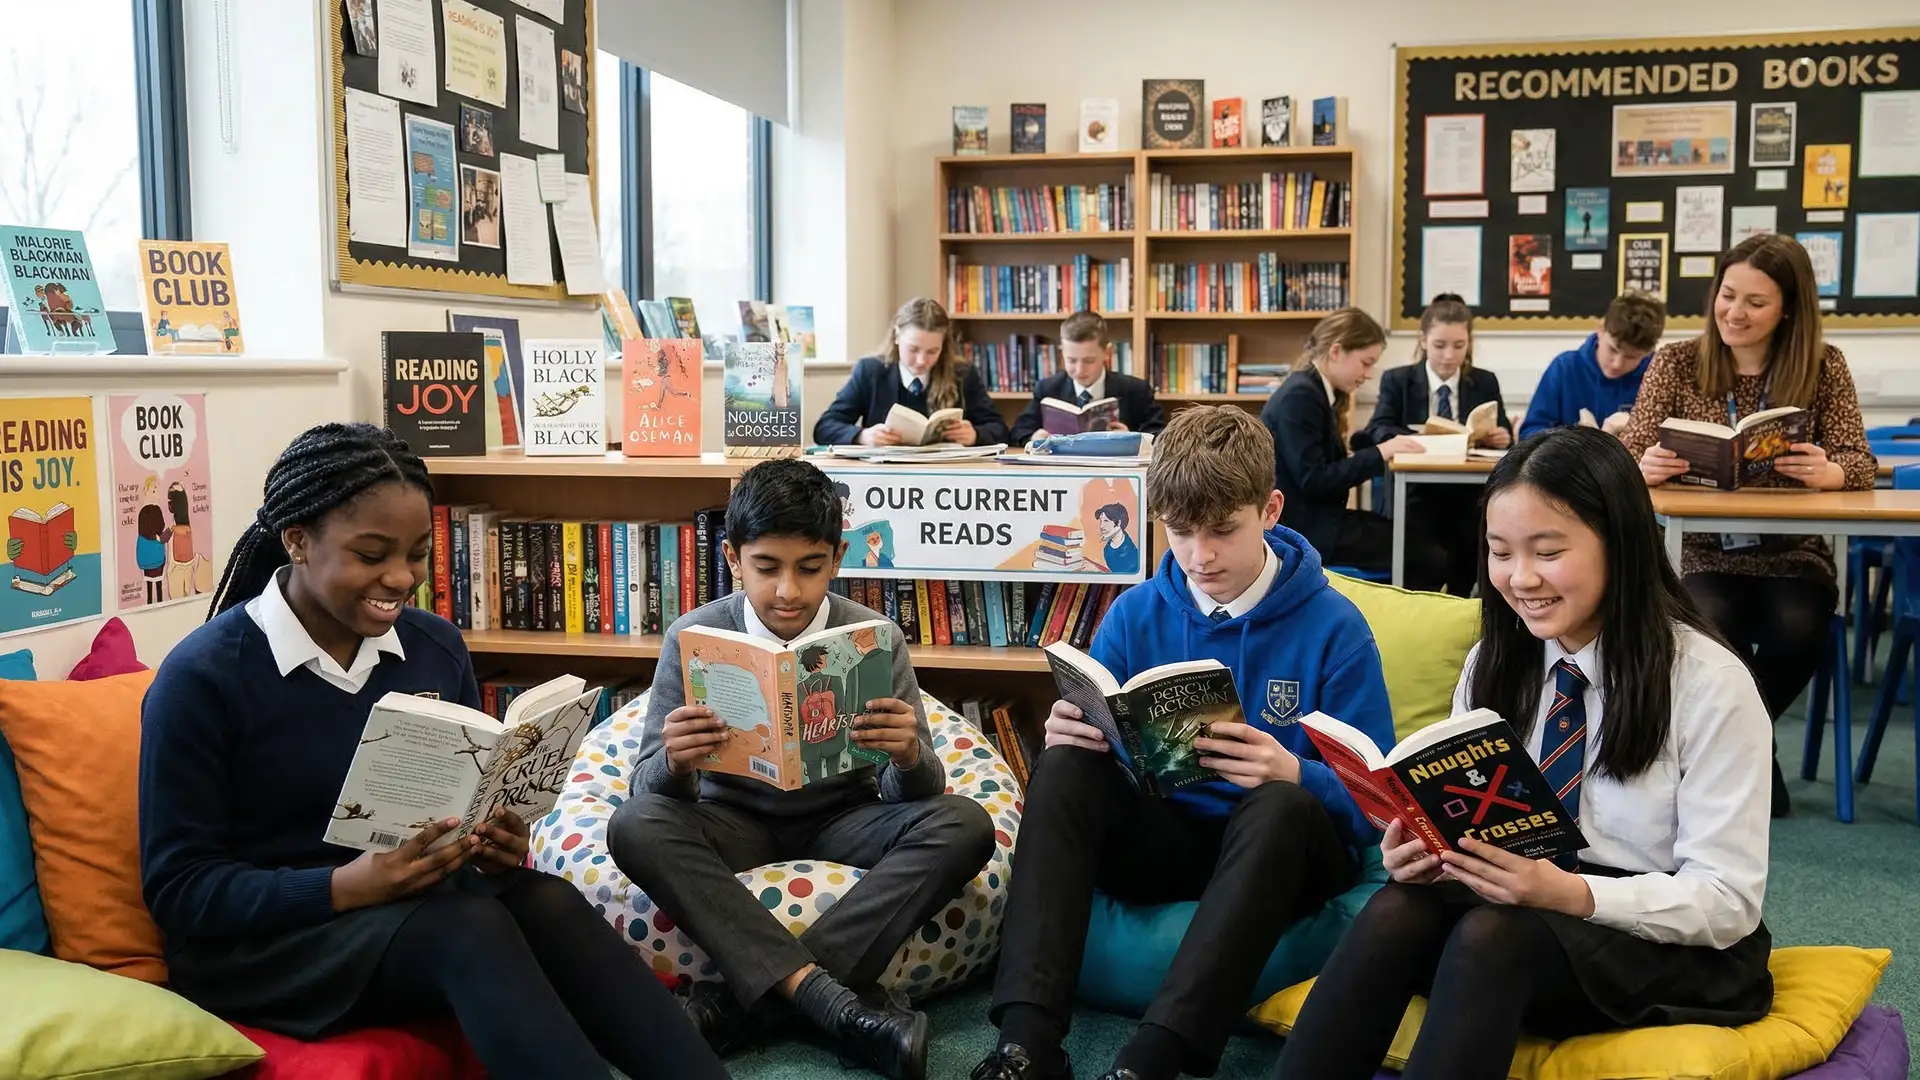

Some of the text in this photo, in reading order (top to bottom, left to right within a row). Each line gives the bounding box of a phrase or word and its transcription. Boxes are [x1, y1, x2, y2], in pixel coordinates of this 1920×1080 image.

[1454, 53, 1900, 101] RECOMMENDED BOOKS
[14, 235, 74, 250] MALORIE
[10, 248, 84, 264] BLACKMAN
[148, 249, 226, 276] BOOK
[13, 264, 91, 281] BLACKMAN
[153, 278, 231, 307] CLUB
[395, 358, 479, 381] READING
[533, 350, 597, 365] HOLLY
[533, 368, 598, 383] BLACK
[396, 383, 478, 415] JOY
[136, 405, 184, 431] BOOK
[639, 413, 686, 429] ALICE
[728, 411, 798, 424] NOUGHTS
[534, 430, 599, 445] BLACK
[629, 429, 694, 446] OSEMAN
[735, 425, 797, 438] CROSSES
[139, 434, 184, 460] CLUB
[2, 456, 80, 494] IS JOY.
[865, 486, 1068, 512] OUR CURRENT
[920, 522, 1012, 546] READS
[1151, 679, 1211, 706] PERCY
[1146, 689, 1230, 725] JACKSON
[534, 744, 551, 757] THE
[1408, 737, 1511, 785] Noughts
[502, 748, 573, 785] CRUEL
[1465, 768, 1488, 787] &
[1463, 810, 1558, 843] Crosses
